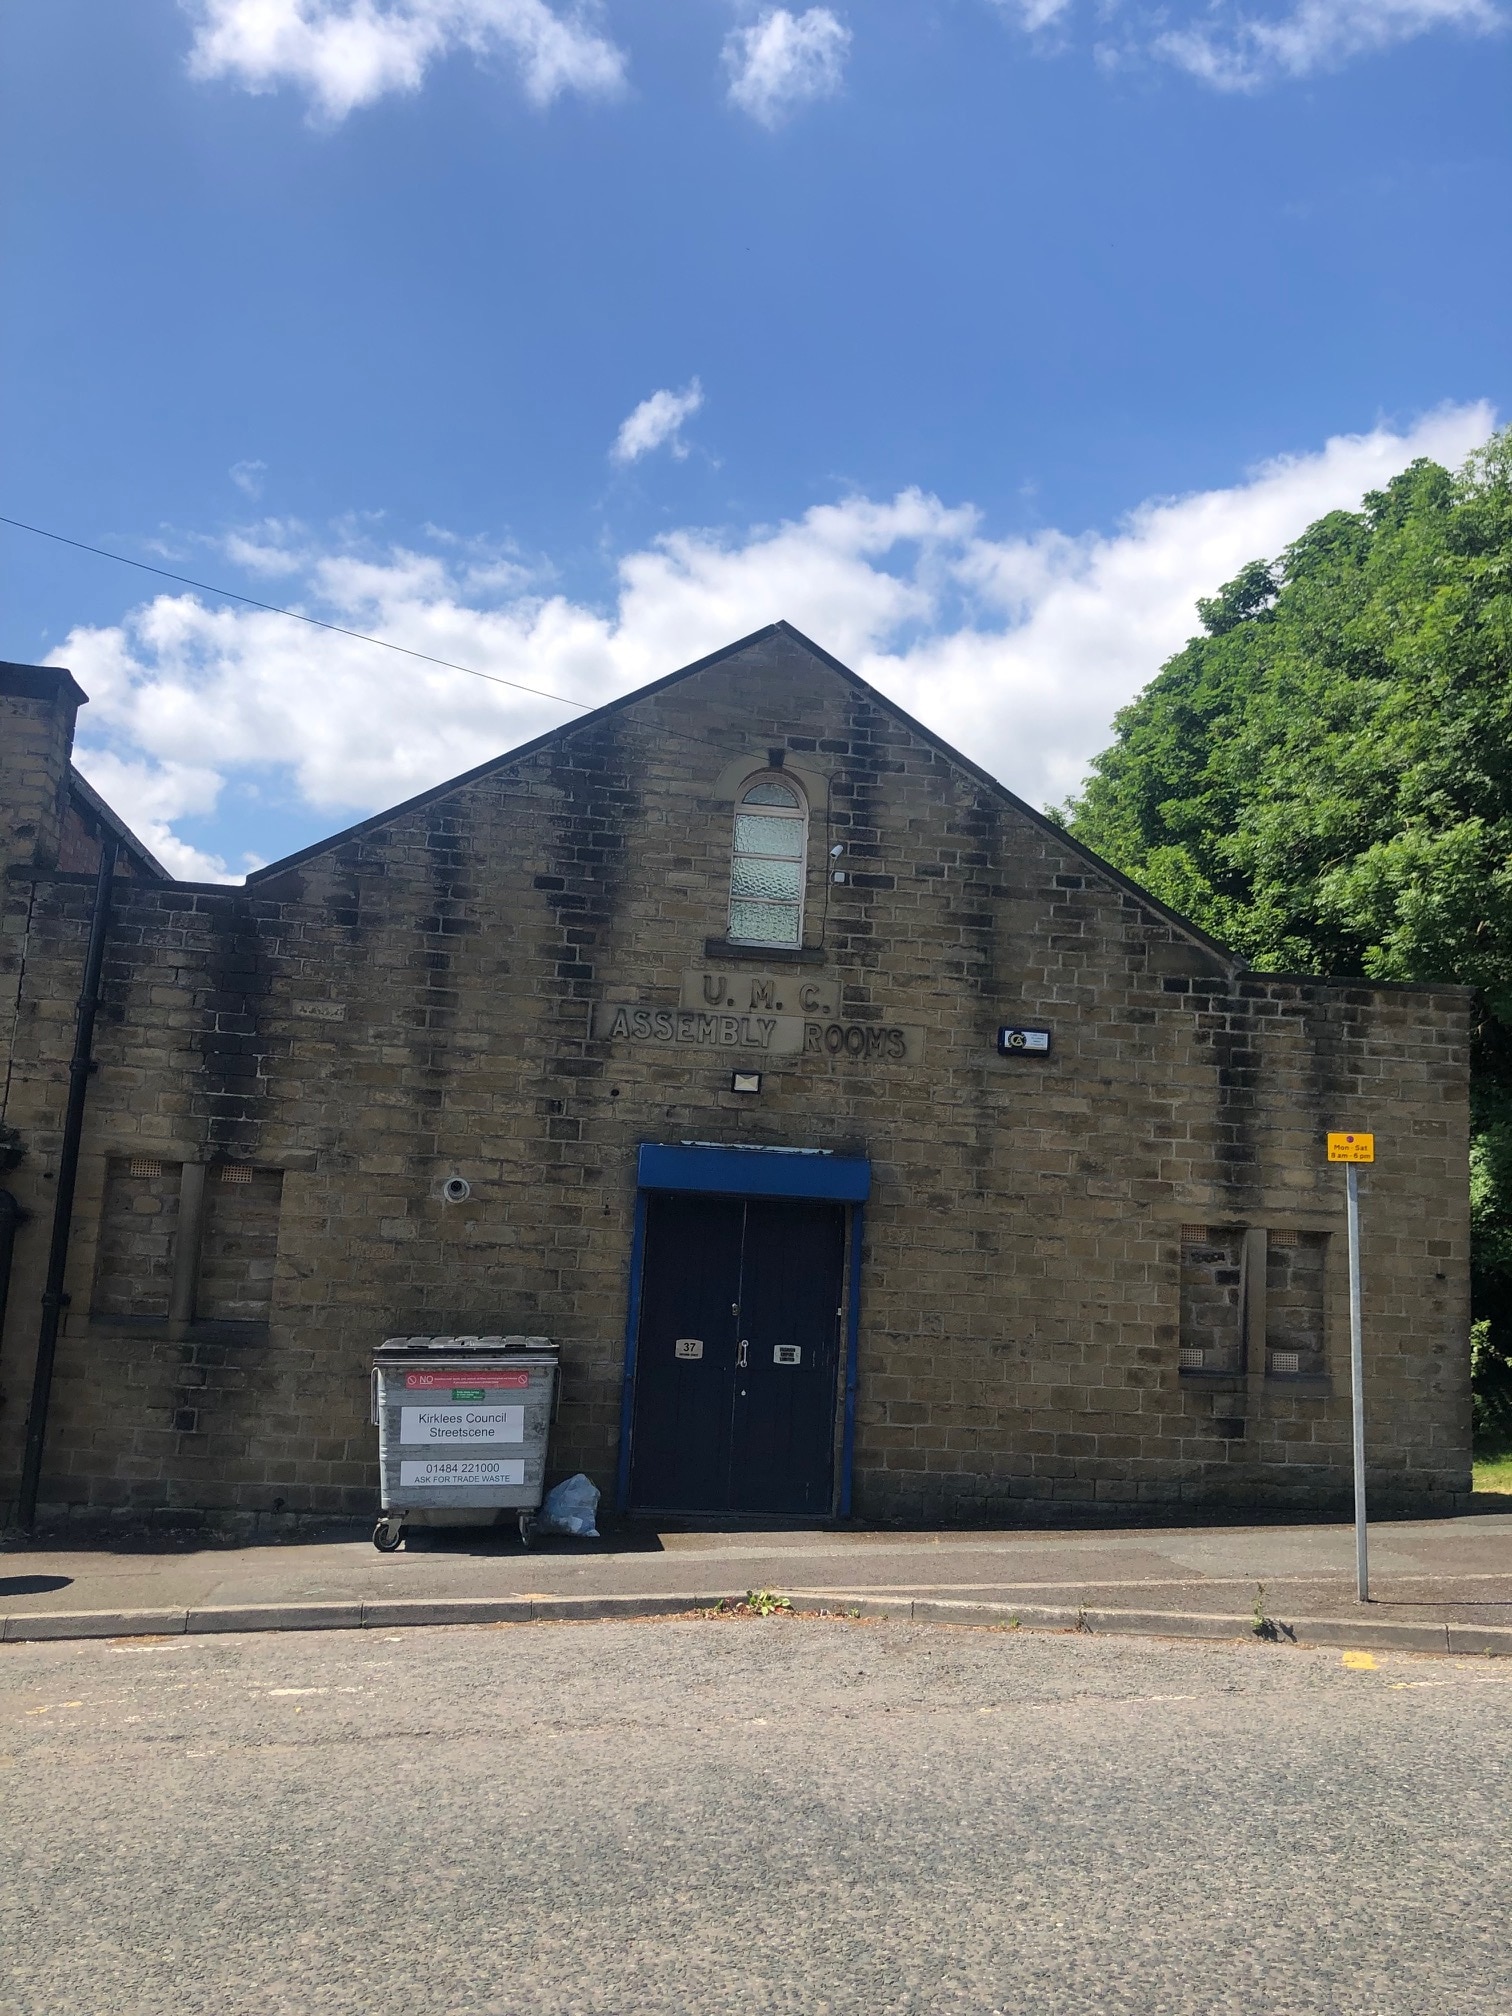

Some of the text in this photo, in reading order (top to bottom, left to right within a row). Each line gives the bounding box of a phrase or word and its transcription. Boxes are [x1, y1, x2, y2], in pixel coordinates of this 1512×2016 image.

[610, 1009, 906, 1059] ASSEMBLY ROOMS
[683, 1342, 696, 1351] 37
[419, 1375, 434, 1384] NO
[419, 1413, 507, 1424] Kirklees Council
[429, 1427, 495, 1437] Streetscene
[426, 1463, 500, 1473] 01484 221000
[453, 1475, 480, 1483] TRADE
[481, 1475, 510, 1483] WASTE
